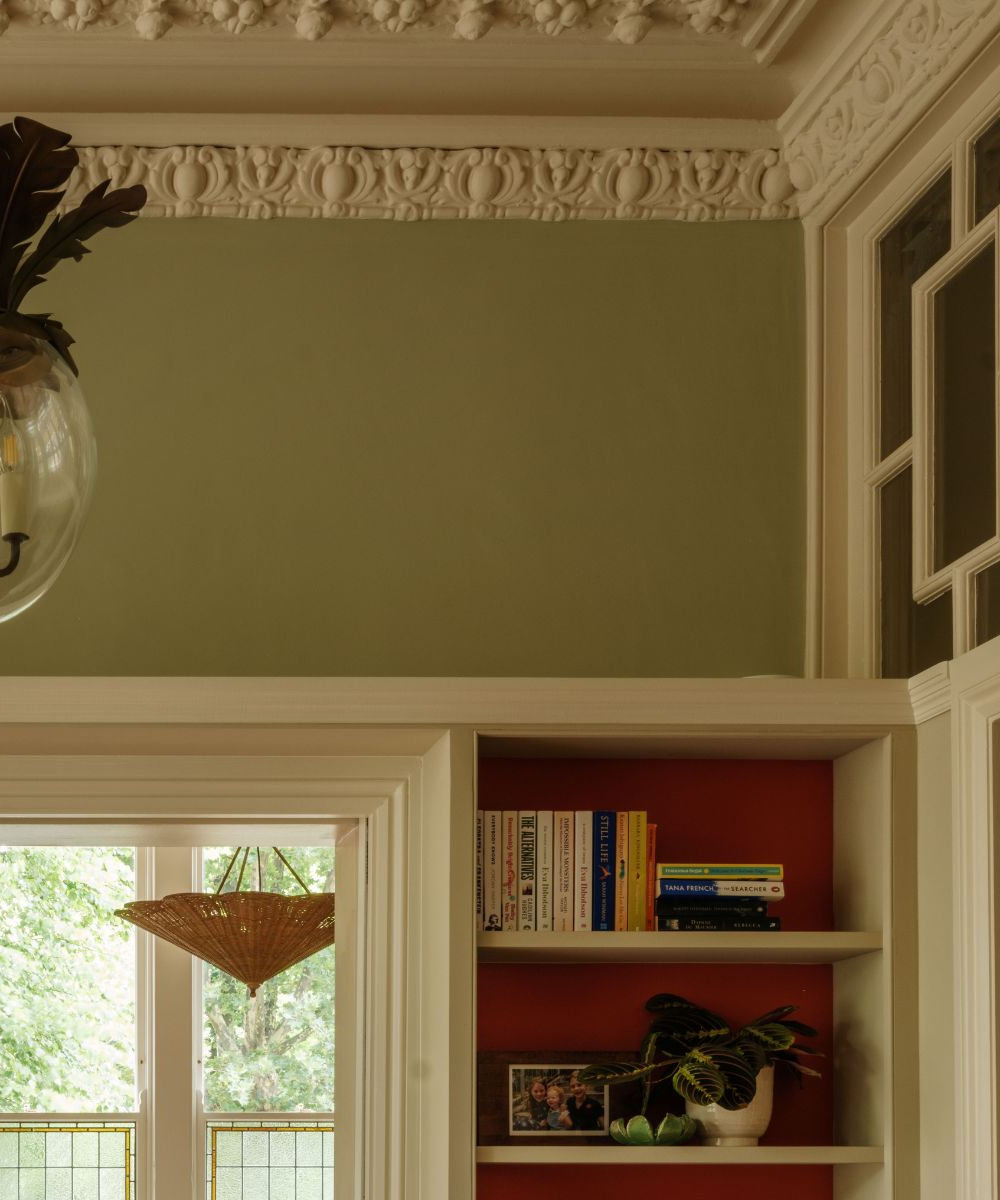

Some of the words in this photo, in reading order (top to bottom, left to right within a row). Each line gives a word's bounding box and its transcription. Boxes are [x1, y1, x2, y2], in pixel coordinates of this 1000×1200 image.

[522, 816, 534, 829] THE
[600, 816, 608, 841] STILL
[521, 832, 534, 880] ALTERNATIVES
